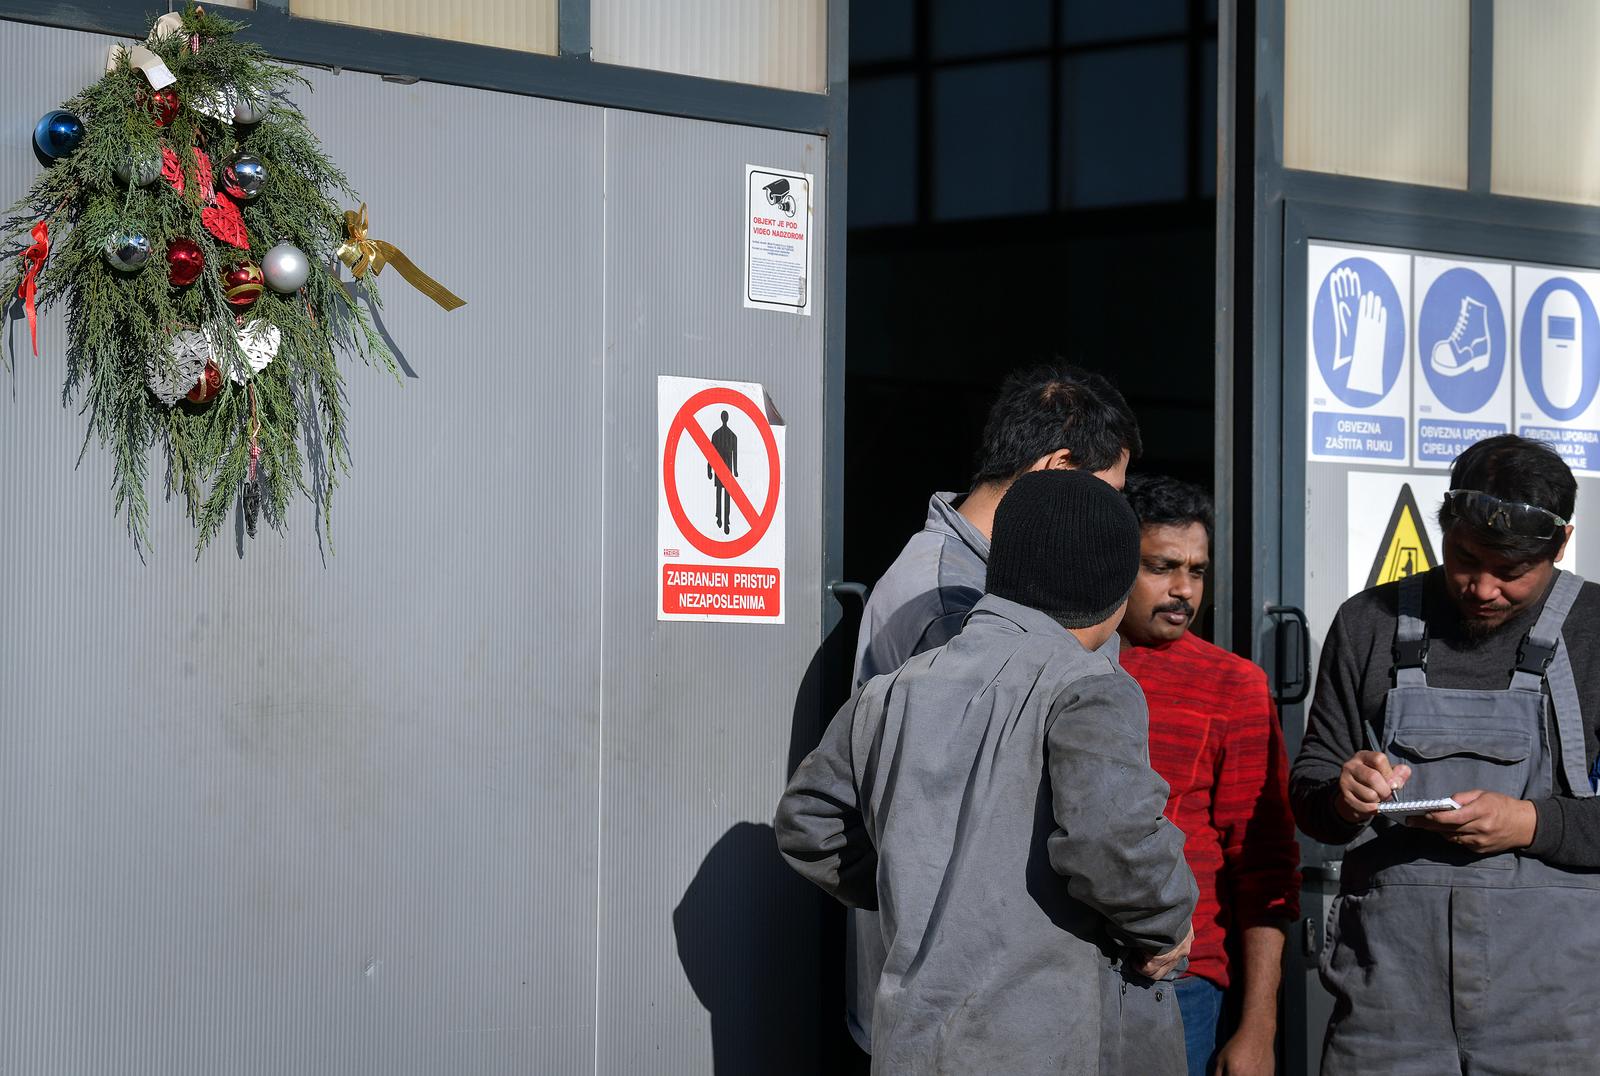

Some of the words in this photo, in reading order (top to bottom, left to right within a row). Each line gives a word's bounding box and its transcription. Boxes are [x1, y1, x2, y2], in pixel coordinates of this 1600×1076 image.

[753, 216, 776, 226] OBJEKT
[785, 221, 798, 229] POD
[753, 227, 771, 236] VIDEO
[771, 230, 804, 240] NADZOROM
[1337, 420, 1381, 434] OBVEZNA
[1420, 426, 1462, 439] OBVEZNA
[1561, 431, 1599, 444] UPORABA
[1325, 436, 1363, 450] ZAŠTITA
[1366, 440, 1393, 453] RUKU
[1422, 443, 1453, 455] CIPELA
[1574, 445, 1586, 456] ZA
[667, 571, 729, 588] ZABRANJEN
[734, 572, 777, 589] PRISTUP
[679, 593, 765, 610] NEZAPOSLENIMA
